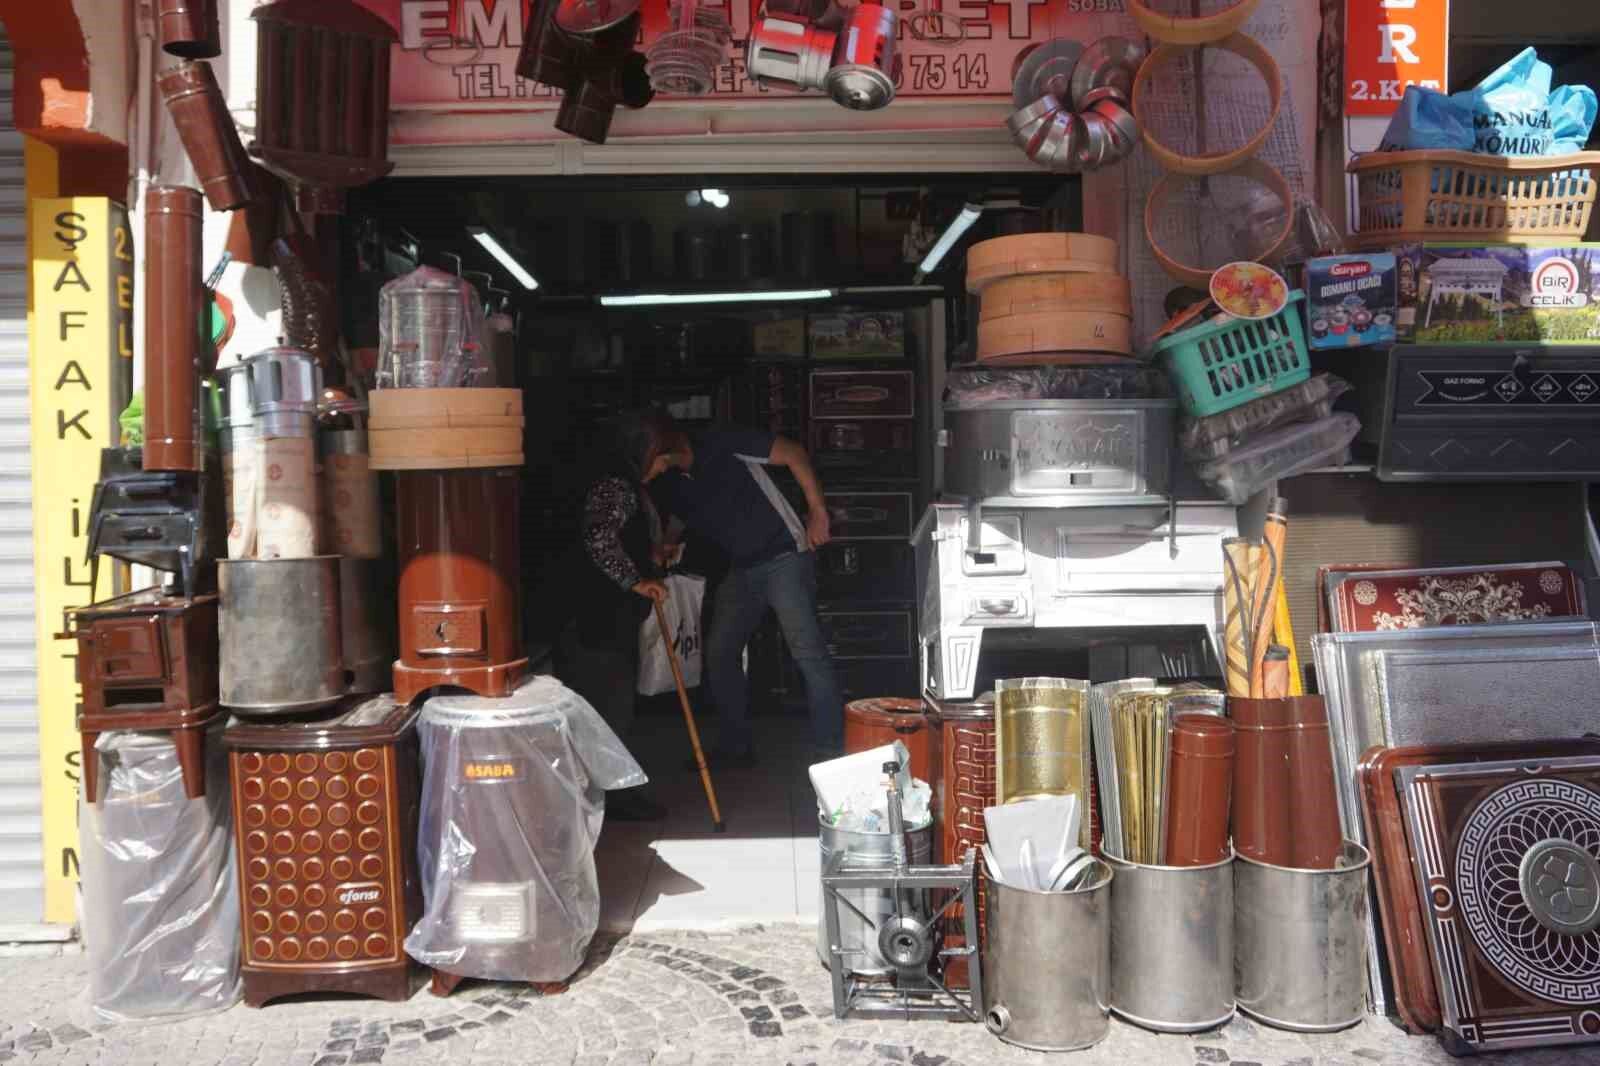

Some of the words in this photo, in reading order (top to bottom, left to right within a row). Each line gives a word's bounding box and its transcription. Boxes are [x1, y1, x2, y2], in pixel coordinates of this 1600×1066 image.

[910, 54, 945, 90] 75
[953, 53, 988, 89] 14
[53, 210, 93, 441] ŞAFAK
